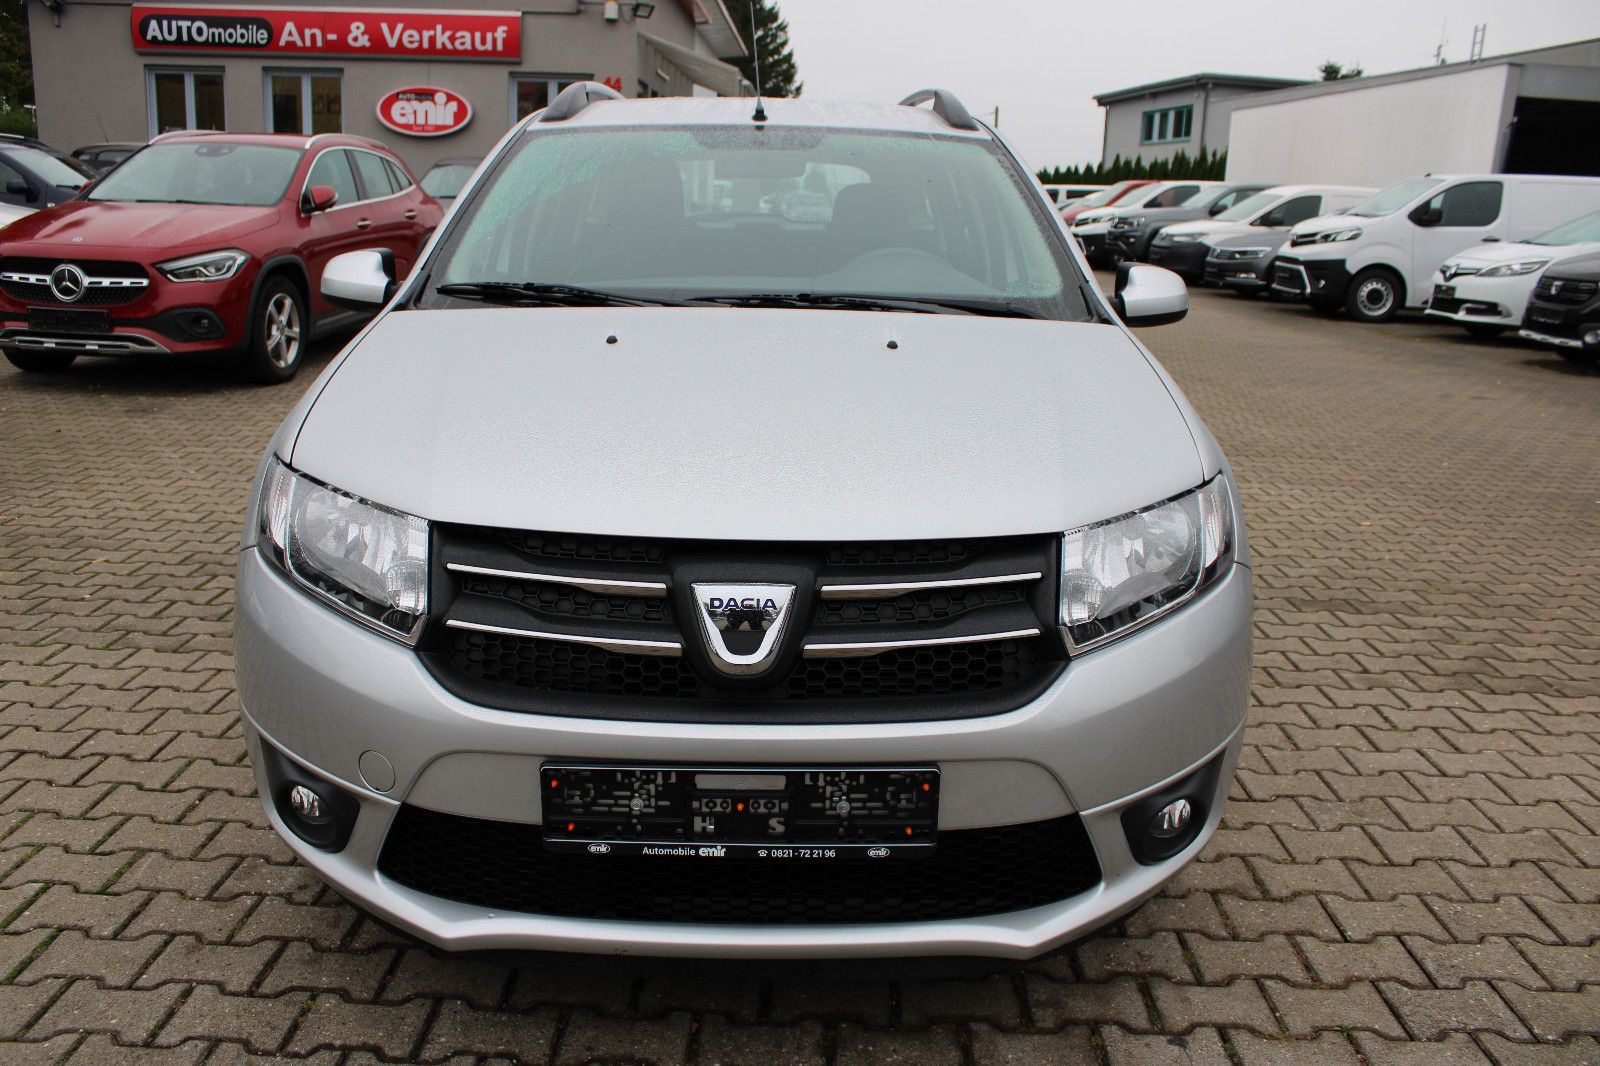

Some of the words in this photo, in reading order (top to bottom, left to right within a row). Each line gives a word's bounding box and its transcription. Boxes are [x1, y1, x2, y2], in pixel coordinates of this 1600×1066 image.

[146, 19, 268, 45] AUTOmobile
[279, 21, 338, 48] An-
[347, 21, 371, 48] &
[380, 22, 508, 51] Verkauf
[391, 91, 458, 126] emir
[709, 597, 778, 611] DACIA
[590, 844, 608, 853] emir
[642, 846, 696, 856] Automobile
[698, 845, 726, 857] emir
